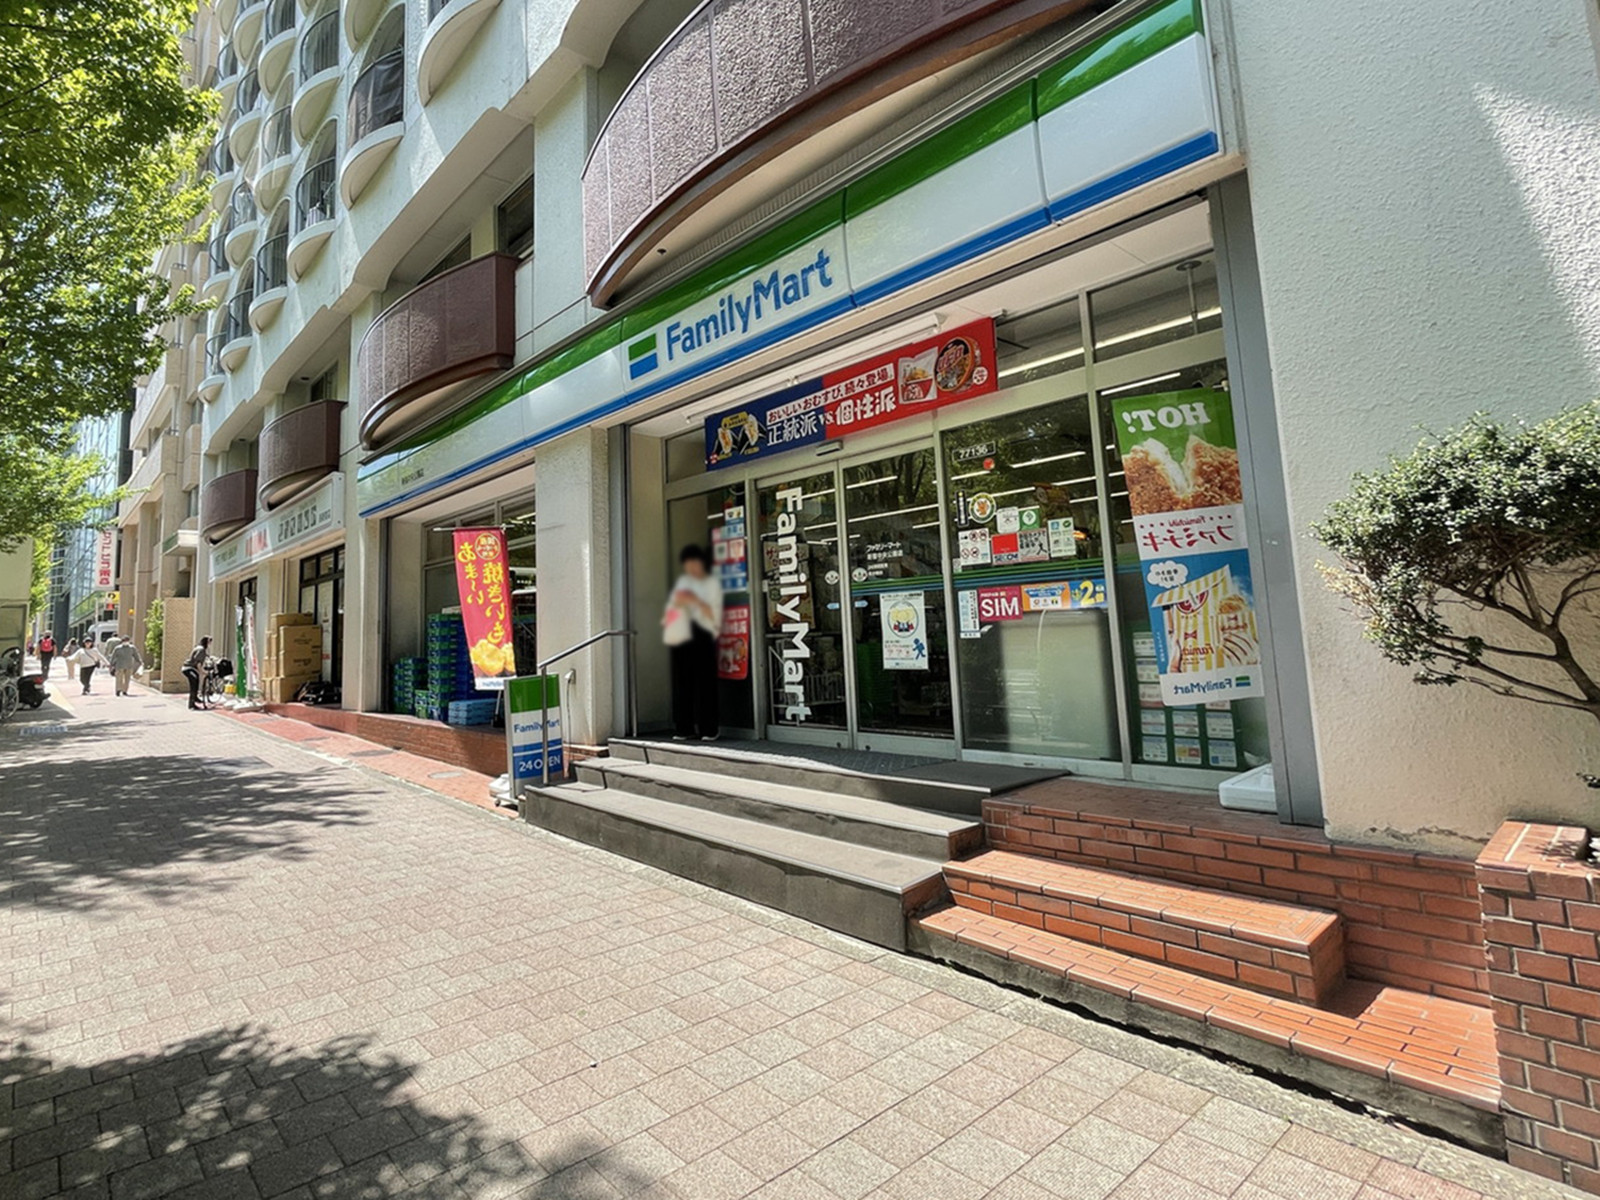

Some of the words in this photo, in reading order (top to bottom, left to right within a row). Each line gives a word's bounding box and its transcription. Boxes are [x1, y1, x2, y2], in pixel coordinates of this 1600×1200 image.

[666, 249, 833, 361] FamilyMart
[767, 411, 818, 446] 正統派
[836, 387, 897, 425] 個性派
[776, 486, 812, 722] FamilyMart
[981, 596, 1019, 617] SIM
[514, 719, 560, 733] Familyart
